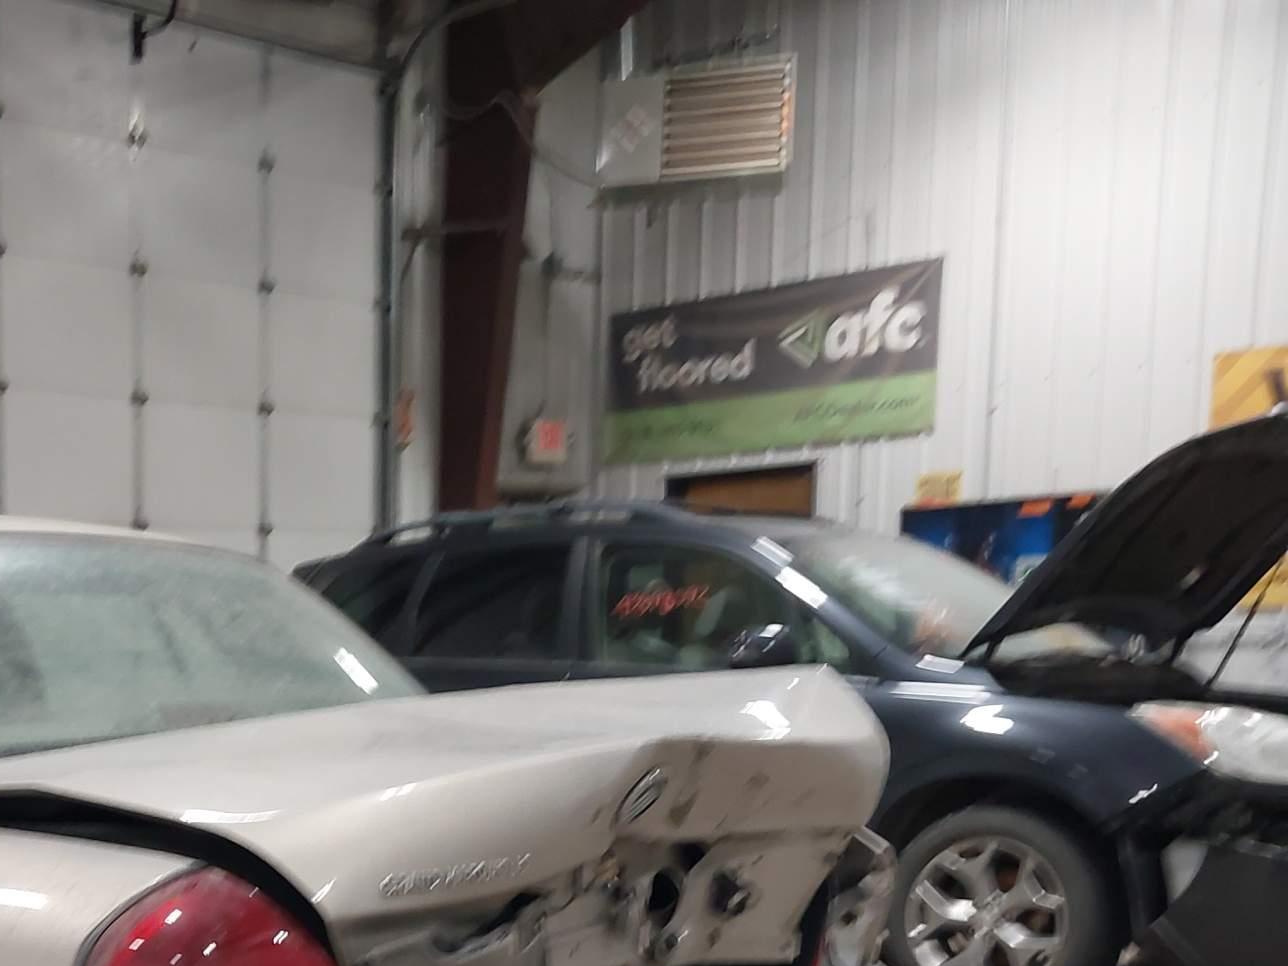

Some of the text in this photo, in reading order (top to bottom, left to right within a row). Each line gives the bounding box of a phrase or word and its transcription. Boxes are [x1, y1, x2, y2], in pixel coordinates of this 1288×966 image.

[622, 314, 678, 363] get
[824, 286, 926, 363] afc
[638, 337, 756, 393] floored
